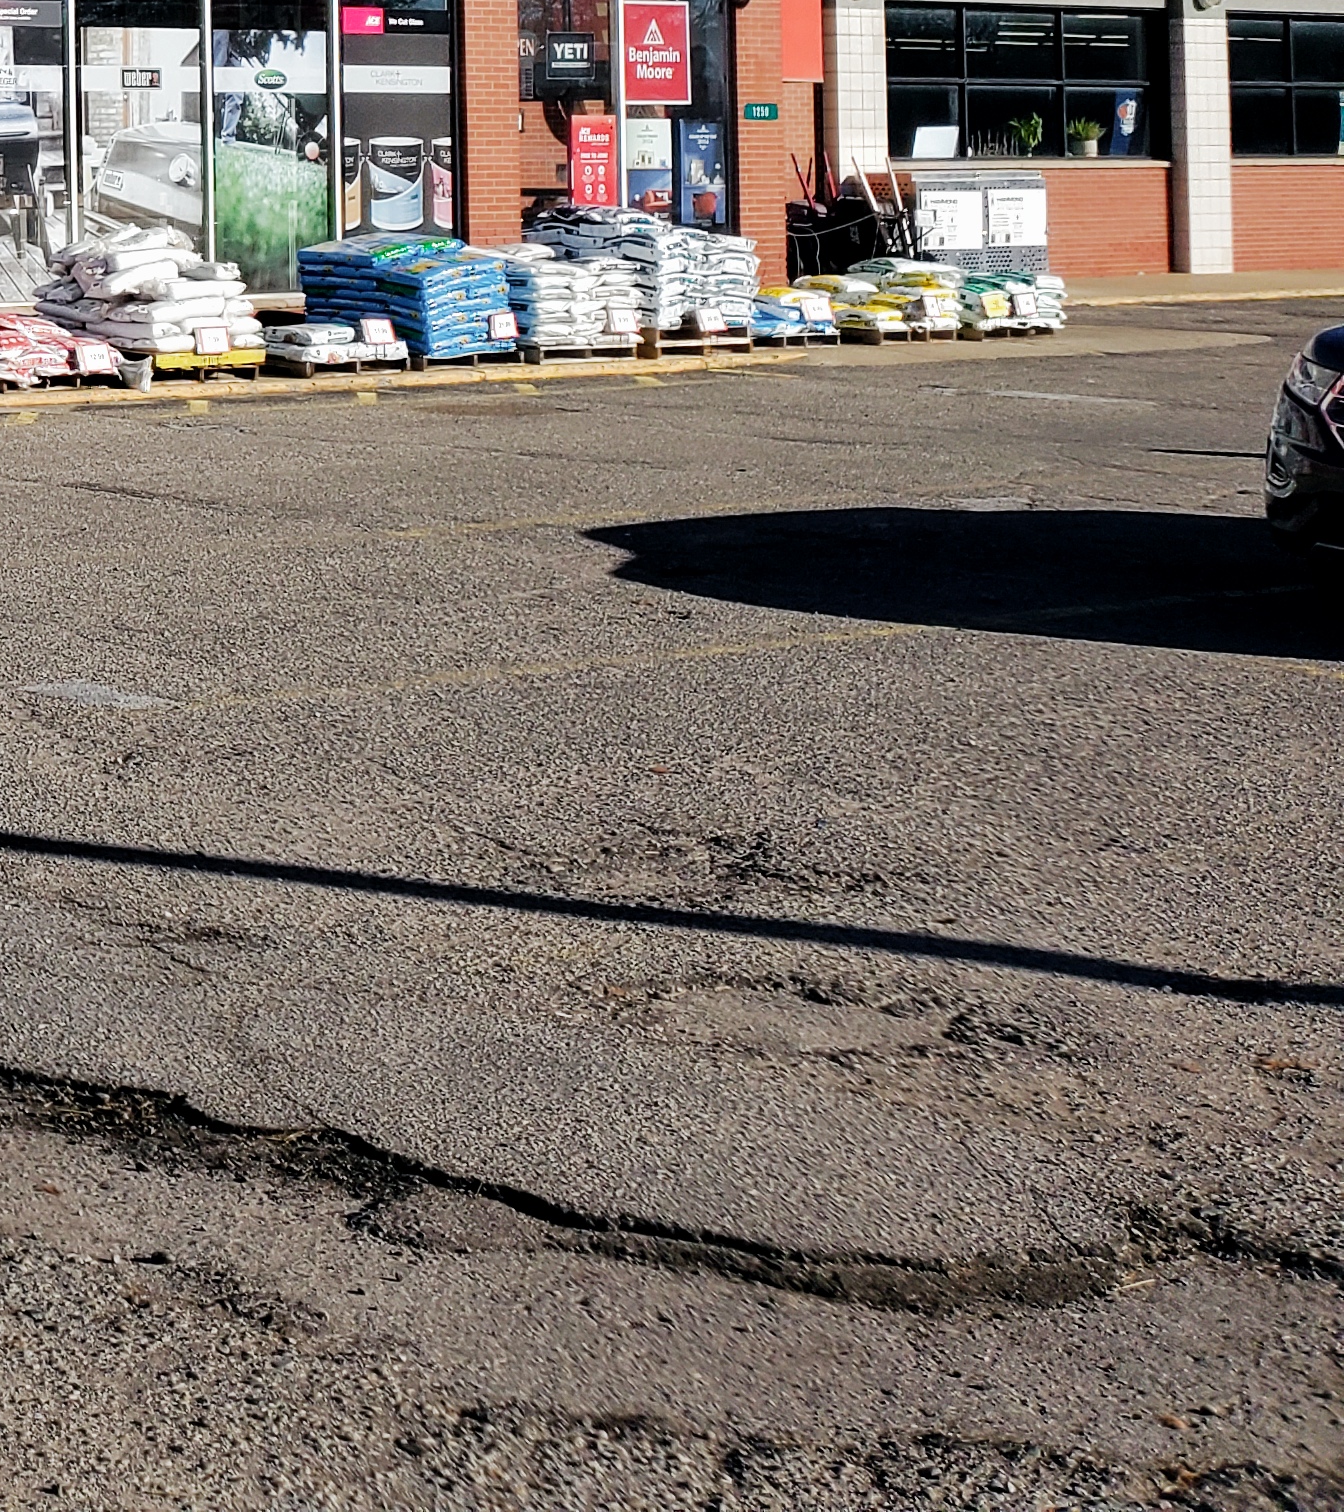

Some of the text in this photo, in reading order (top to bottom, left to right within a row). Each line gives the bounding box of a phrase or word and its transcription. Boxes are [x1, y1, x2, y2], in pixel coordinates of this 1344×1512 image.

[19, 7, 38, 16] Order
[365, 15, 381, 27] ACE
[553, 43, 588, 59] YETI
[628, 46, 681, 66] Benjamin
[636, 63, 673, 79] Moore
[123, 69, 152, 87] weber
[257, 73, 285, 85] Scotts
[375, 78, 423, 86] KENSINGTON
[752, 105, 770, 118] 1250
